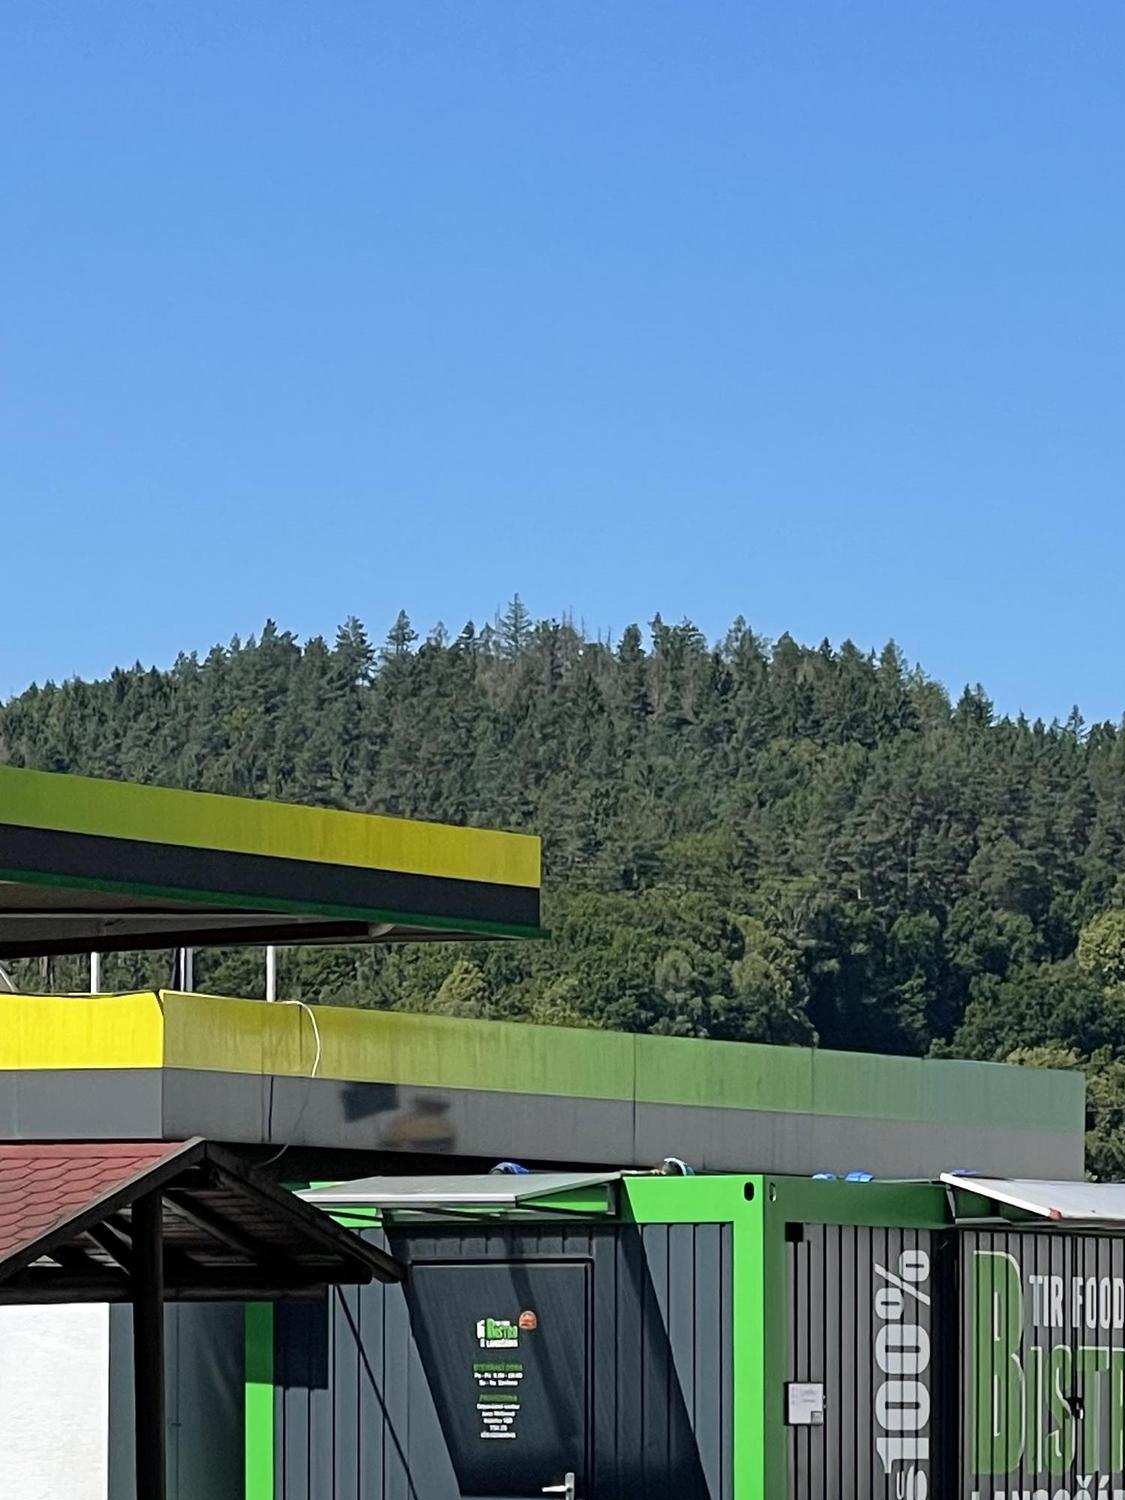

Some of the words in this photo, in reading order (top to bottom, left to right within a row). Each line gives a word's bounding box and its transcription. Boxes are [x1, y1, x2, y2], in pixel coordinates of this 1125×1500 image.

[875, 1250, 931, 1474] 100%
[1029, 1275, 1063, 1328] TIR
[1072, 1277, 1124, 1329] FOOD
